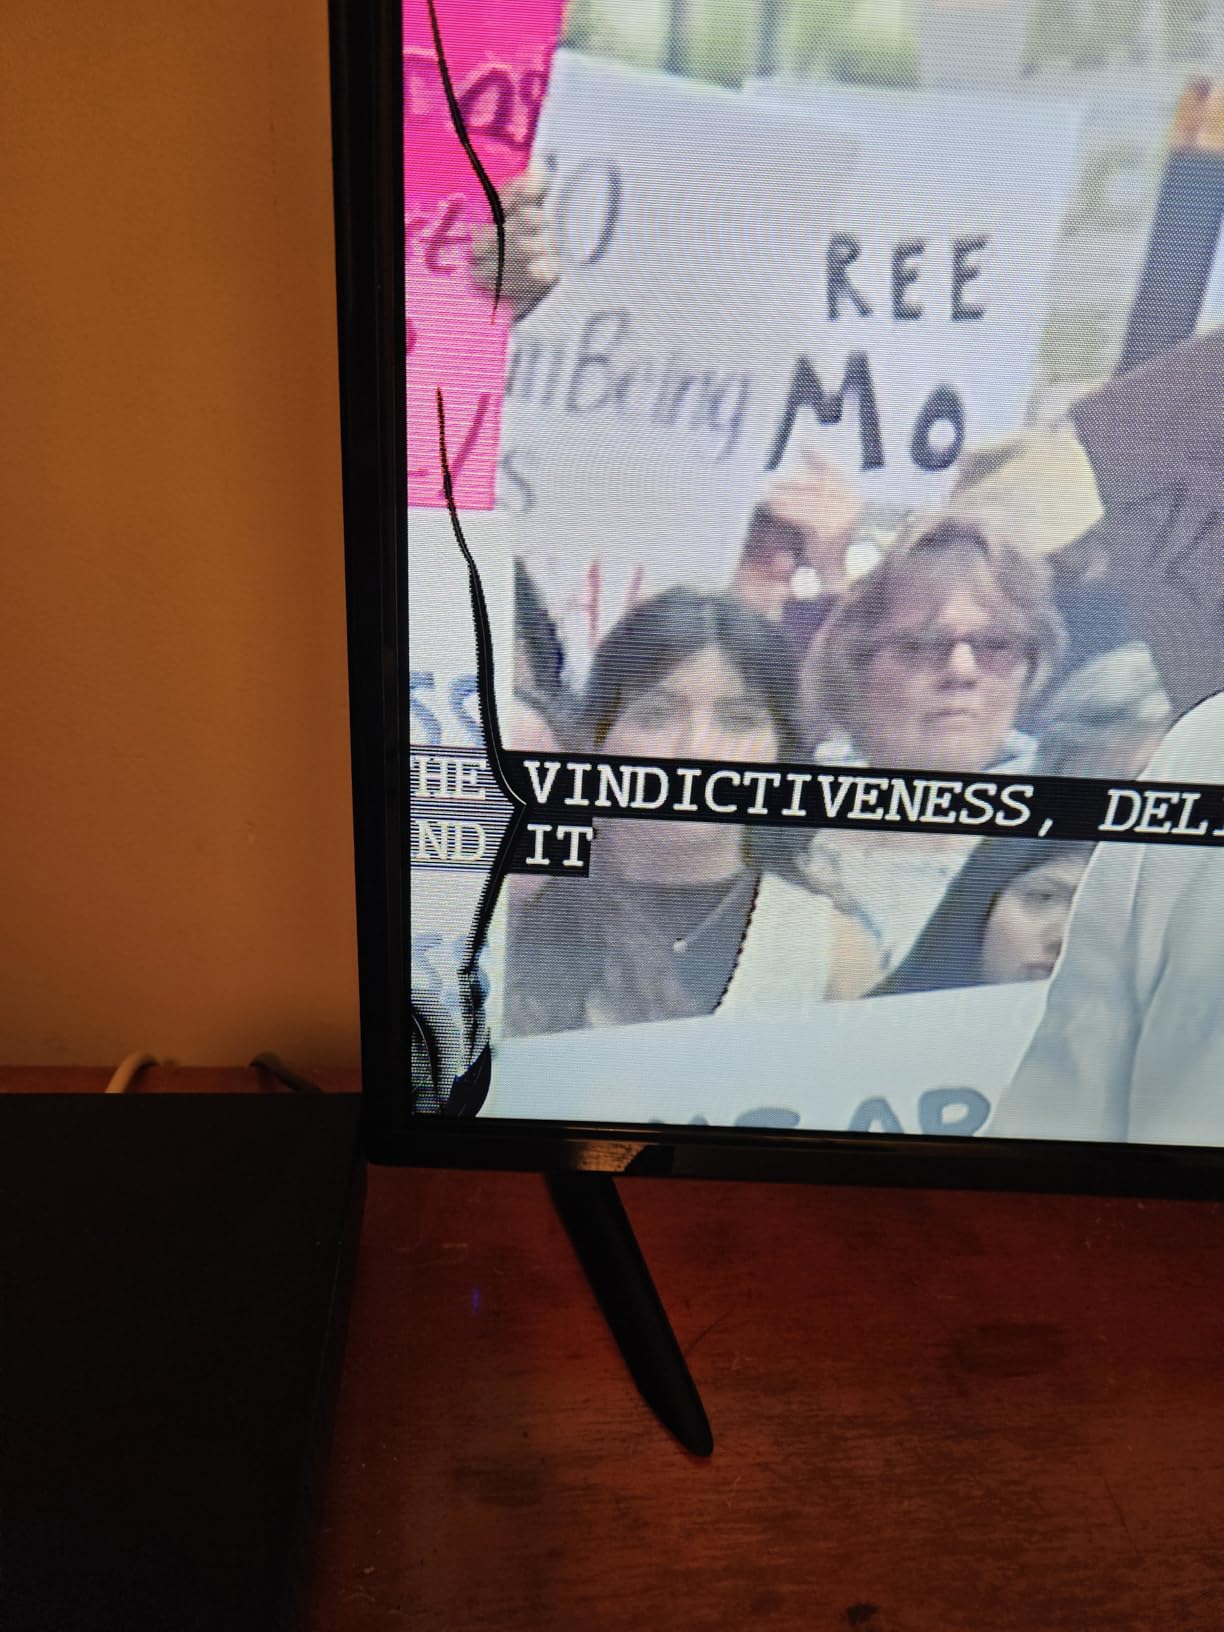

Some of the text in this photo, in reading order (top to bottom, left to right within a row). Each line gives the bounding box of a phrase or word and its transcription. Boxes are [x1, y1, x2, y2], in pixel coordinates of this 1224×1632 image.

[825, 232, 989, 320] REE
[765, 350, 966, 472] MO
[410, 755, 1224, 837] HE VINDICTIVENESS, DEL
[410, 820, 593, 867] ND IT
